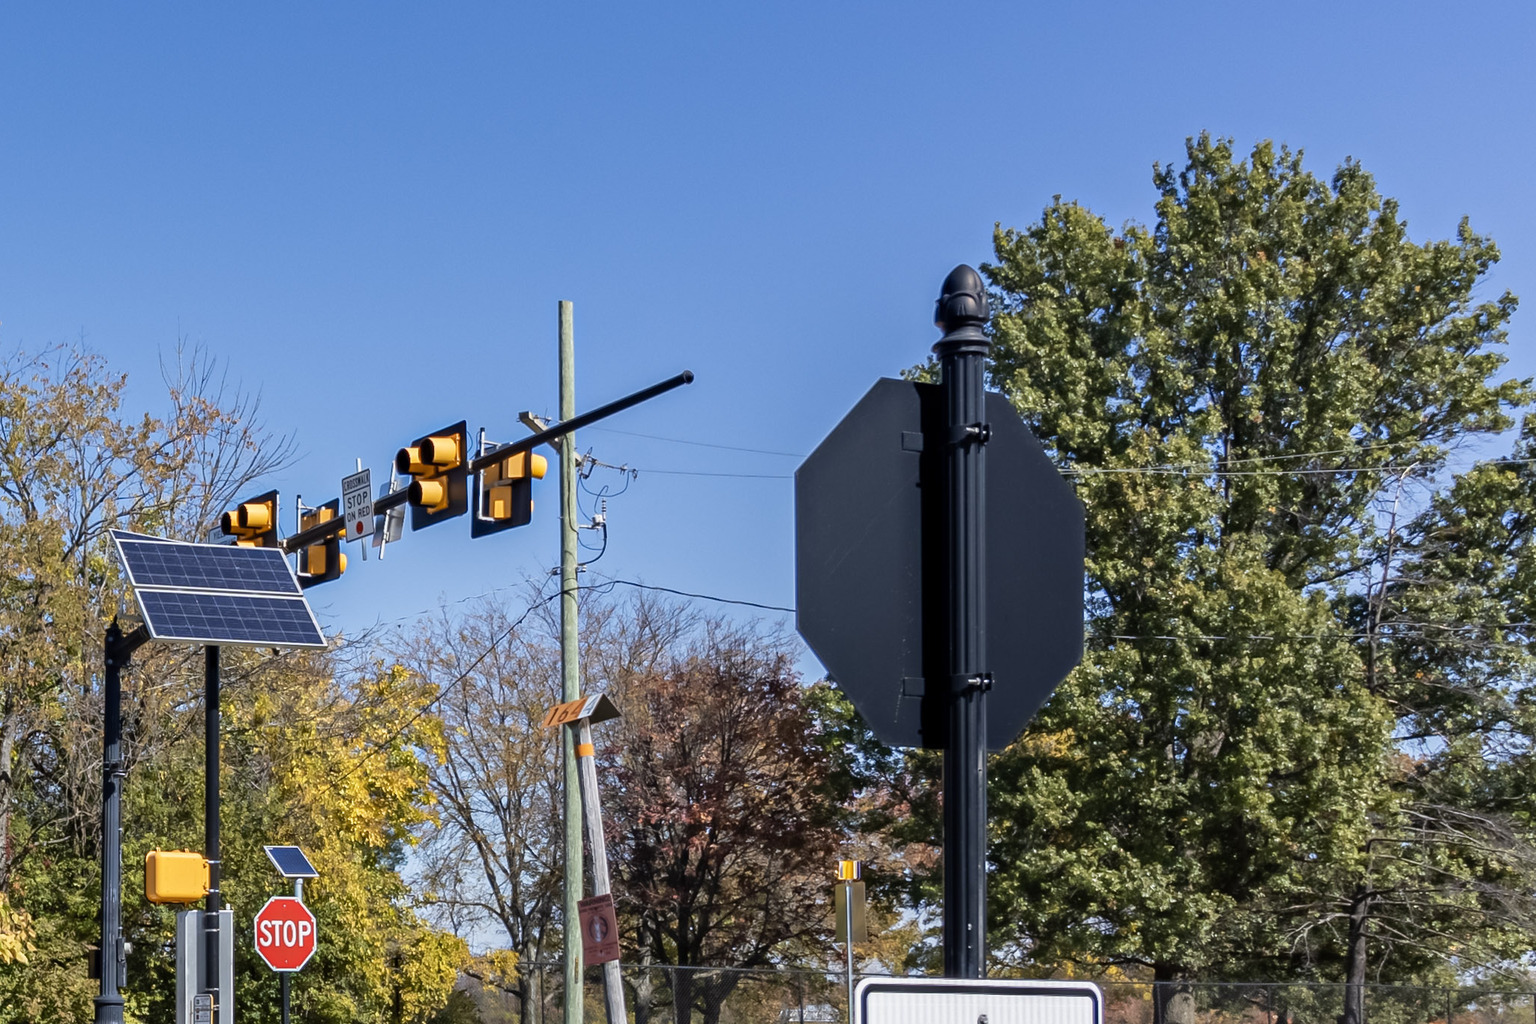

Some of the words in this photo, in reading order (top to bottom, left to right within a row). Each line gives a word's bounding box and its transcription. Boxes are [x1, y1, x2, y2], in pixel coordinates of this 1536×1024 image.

[344, 473, 369, 492] CROSSWALK
[347, 491, 368, 509] STOP
[347, 511, 356, 522] ON
[358, 505, 370, 518] RED
[259, 920, 311, 947] STOP
